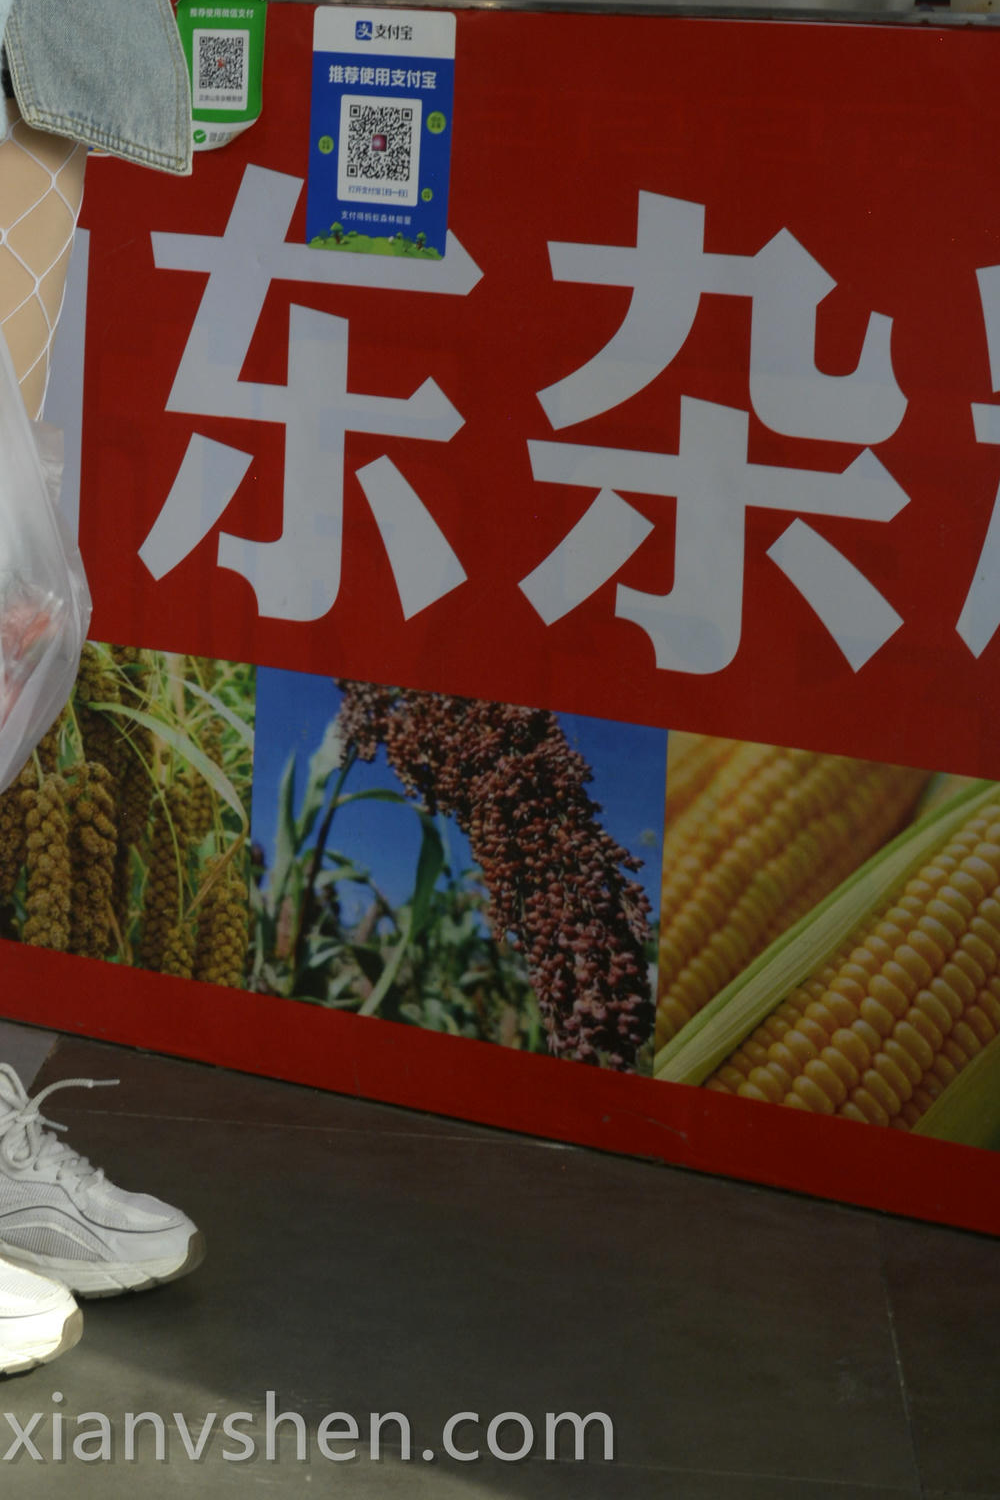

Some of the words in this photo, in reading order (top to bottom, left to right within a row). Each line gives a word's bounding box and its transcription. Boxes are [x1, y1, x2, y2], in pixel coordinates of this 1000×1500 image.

[375, 24, 413, 41] 支付宝
[328, 64, 438, 90] 推荐使用支付宝
[137, 163, 1000, 675] 东杂
